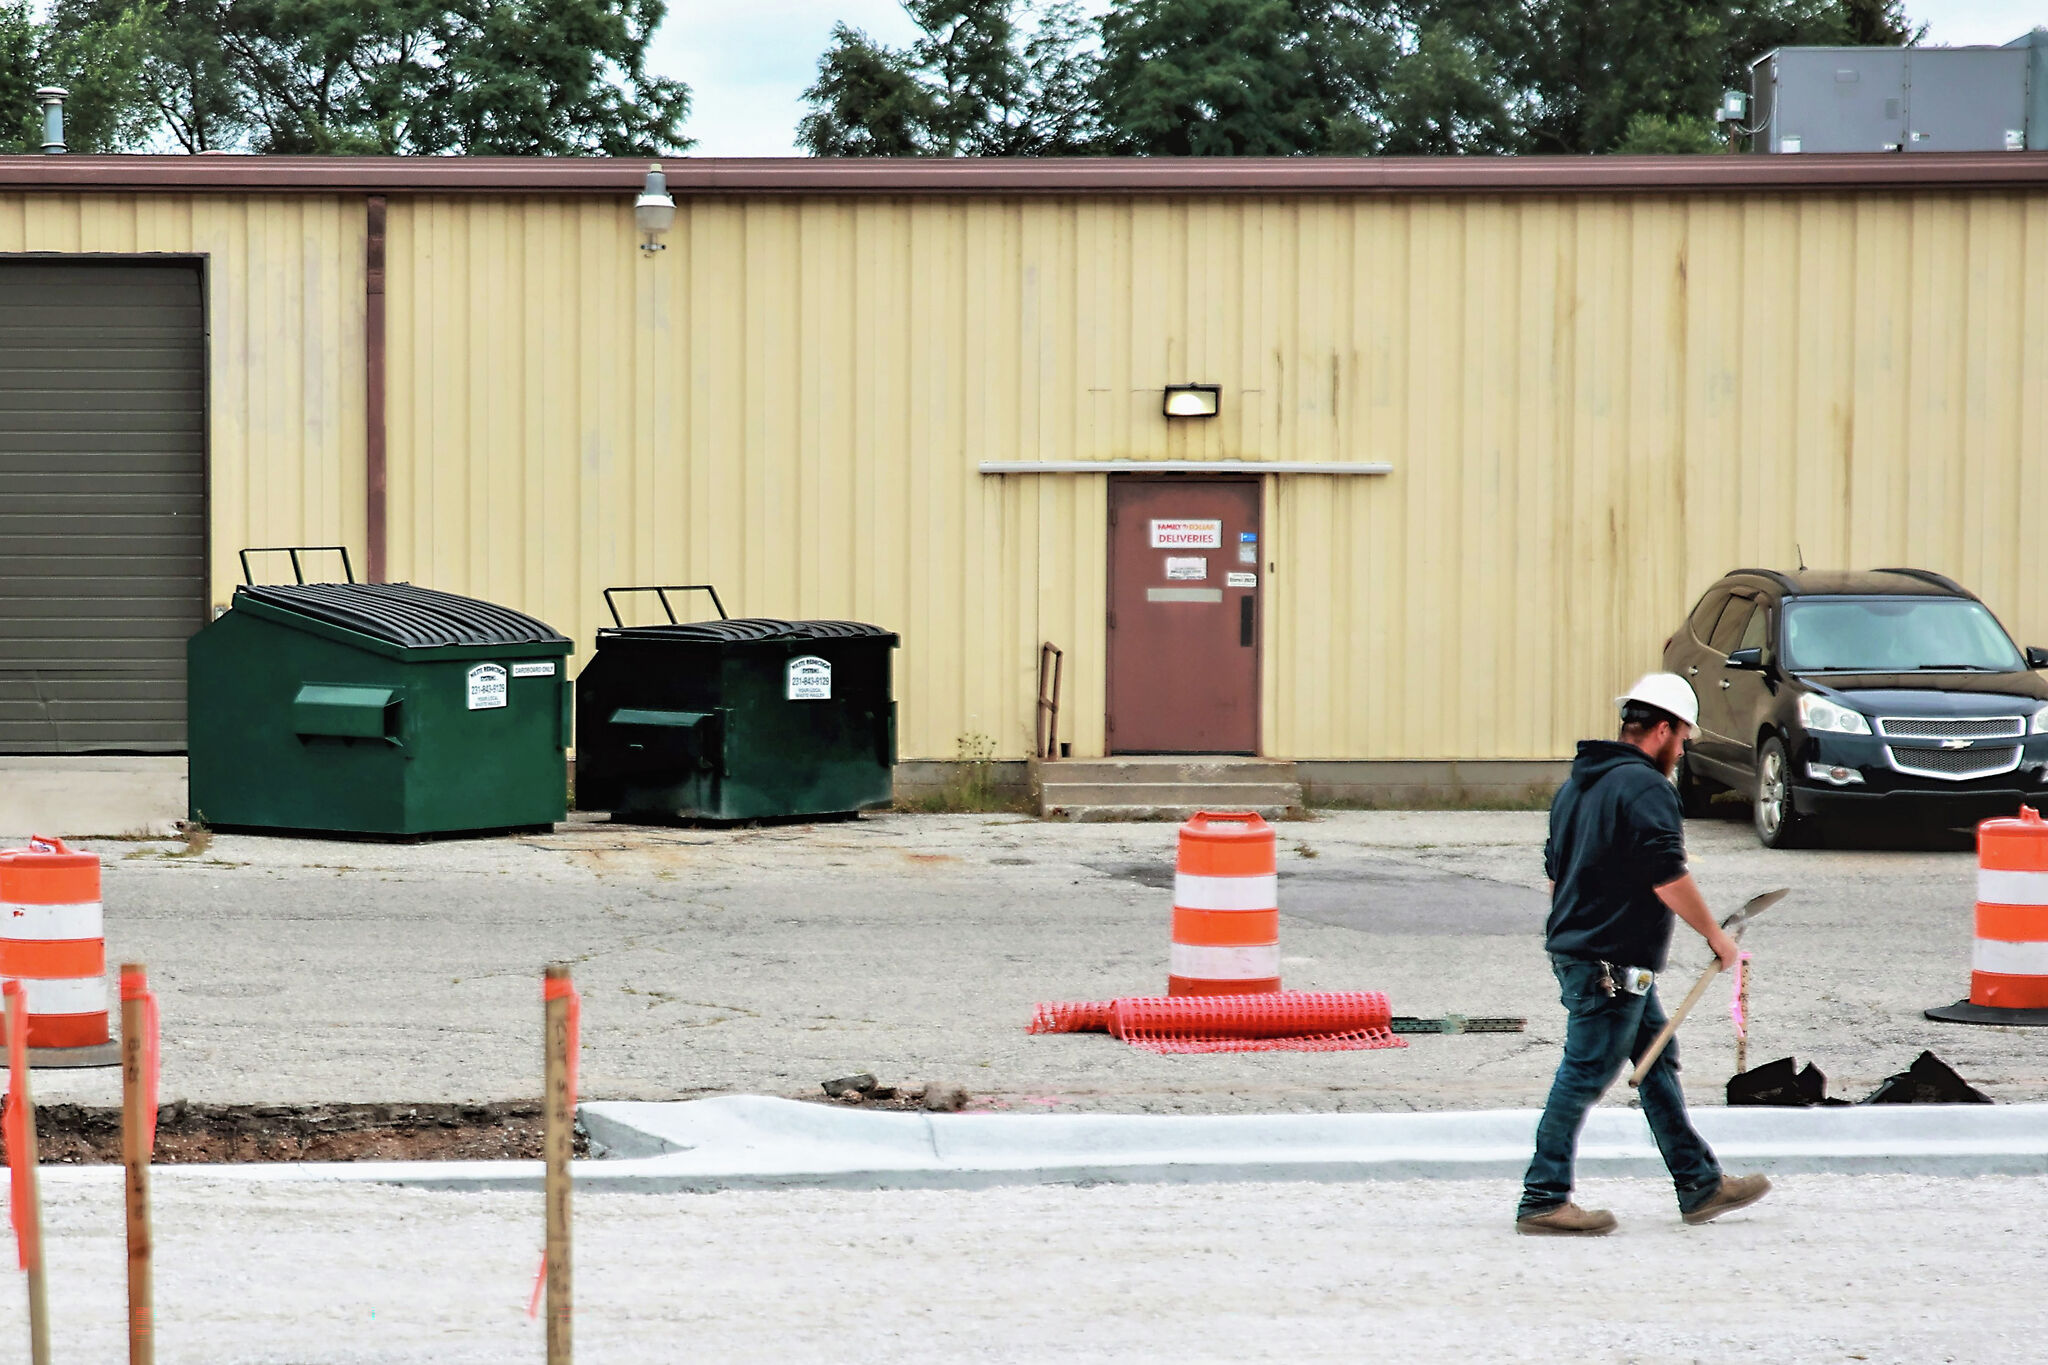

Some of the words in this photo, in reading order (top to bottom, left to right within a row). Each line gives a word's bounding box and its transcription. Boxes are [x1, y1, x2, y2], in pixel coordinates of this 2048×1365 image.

[1157, 523, 1181, 531] FAMILY
[1159, 534, 1214, 543] DELIVERIES
[542, 665, 554, 673] ONLY
[792, 677, 829, 685] 231-843-9129
[471, 684, 505, 695] 231-843-9129
